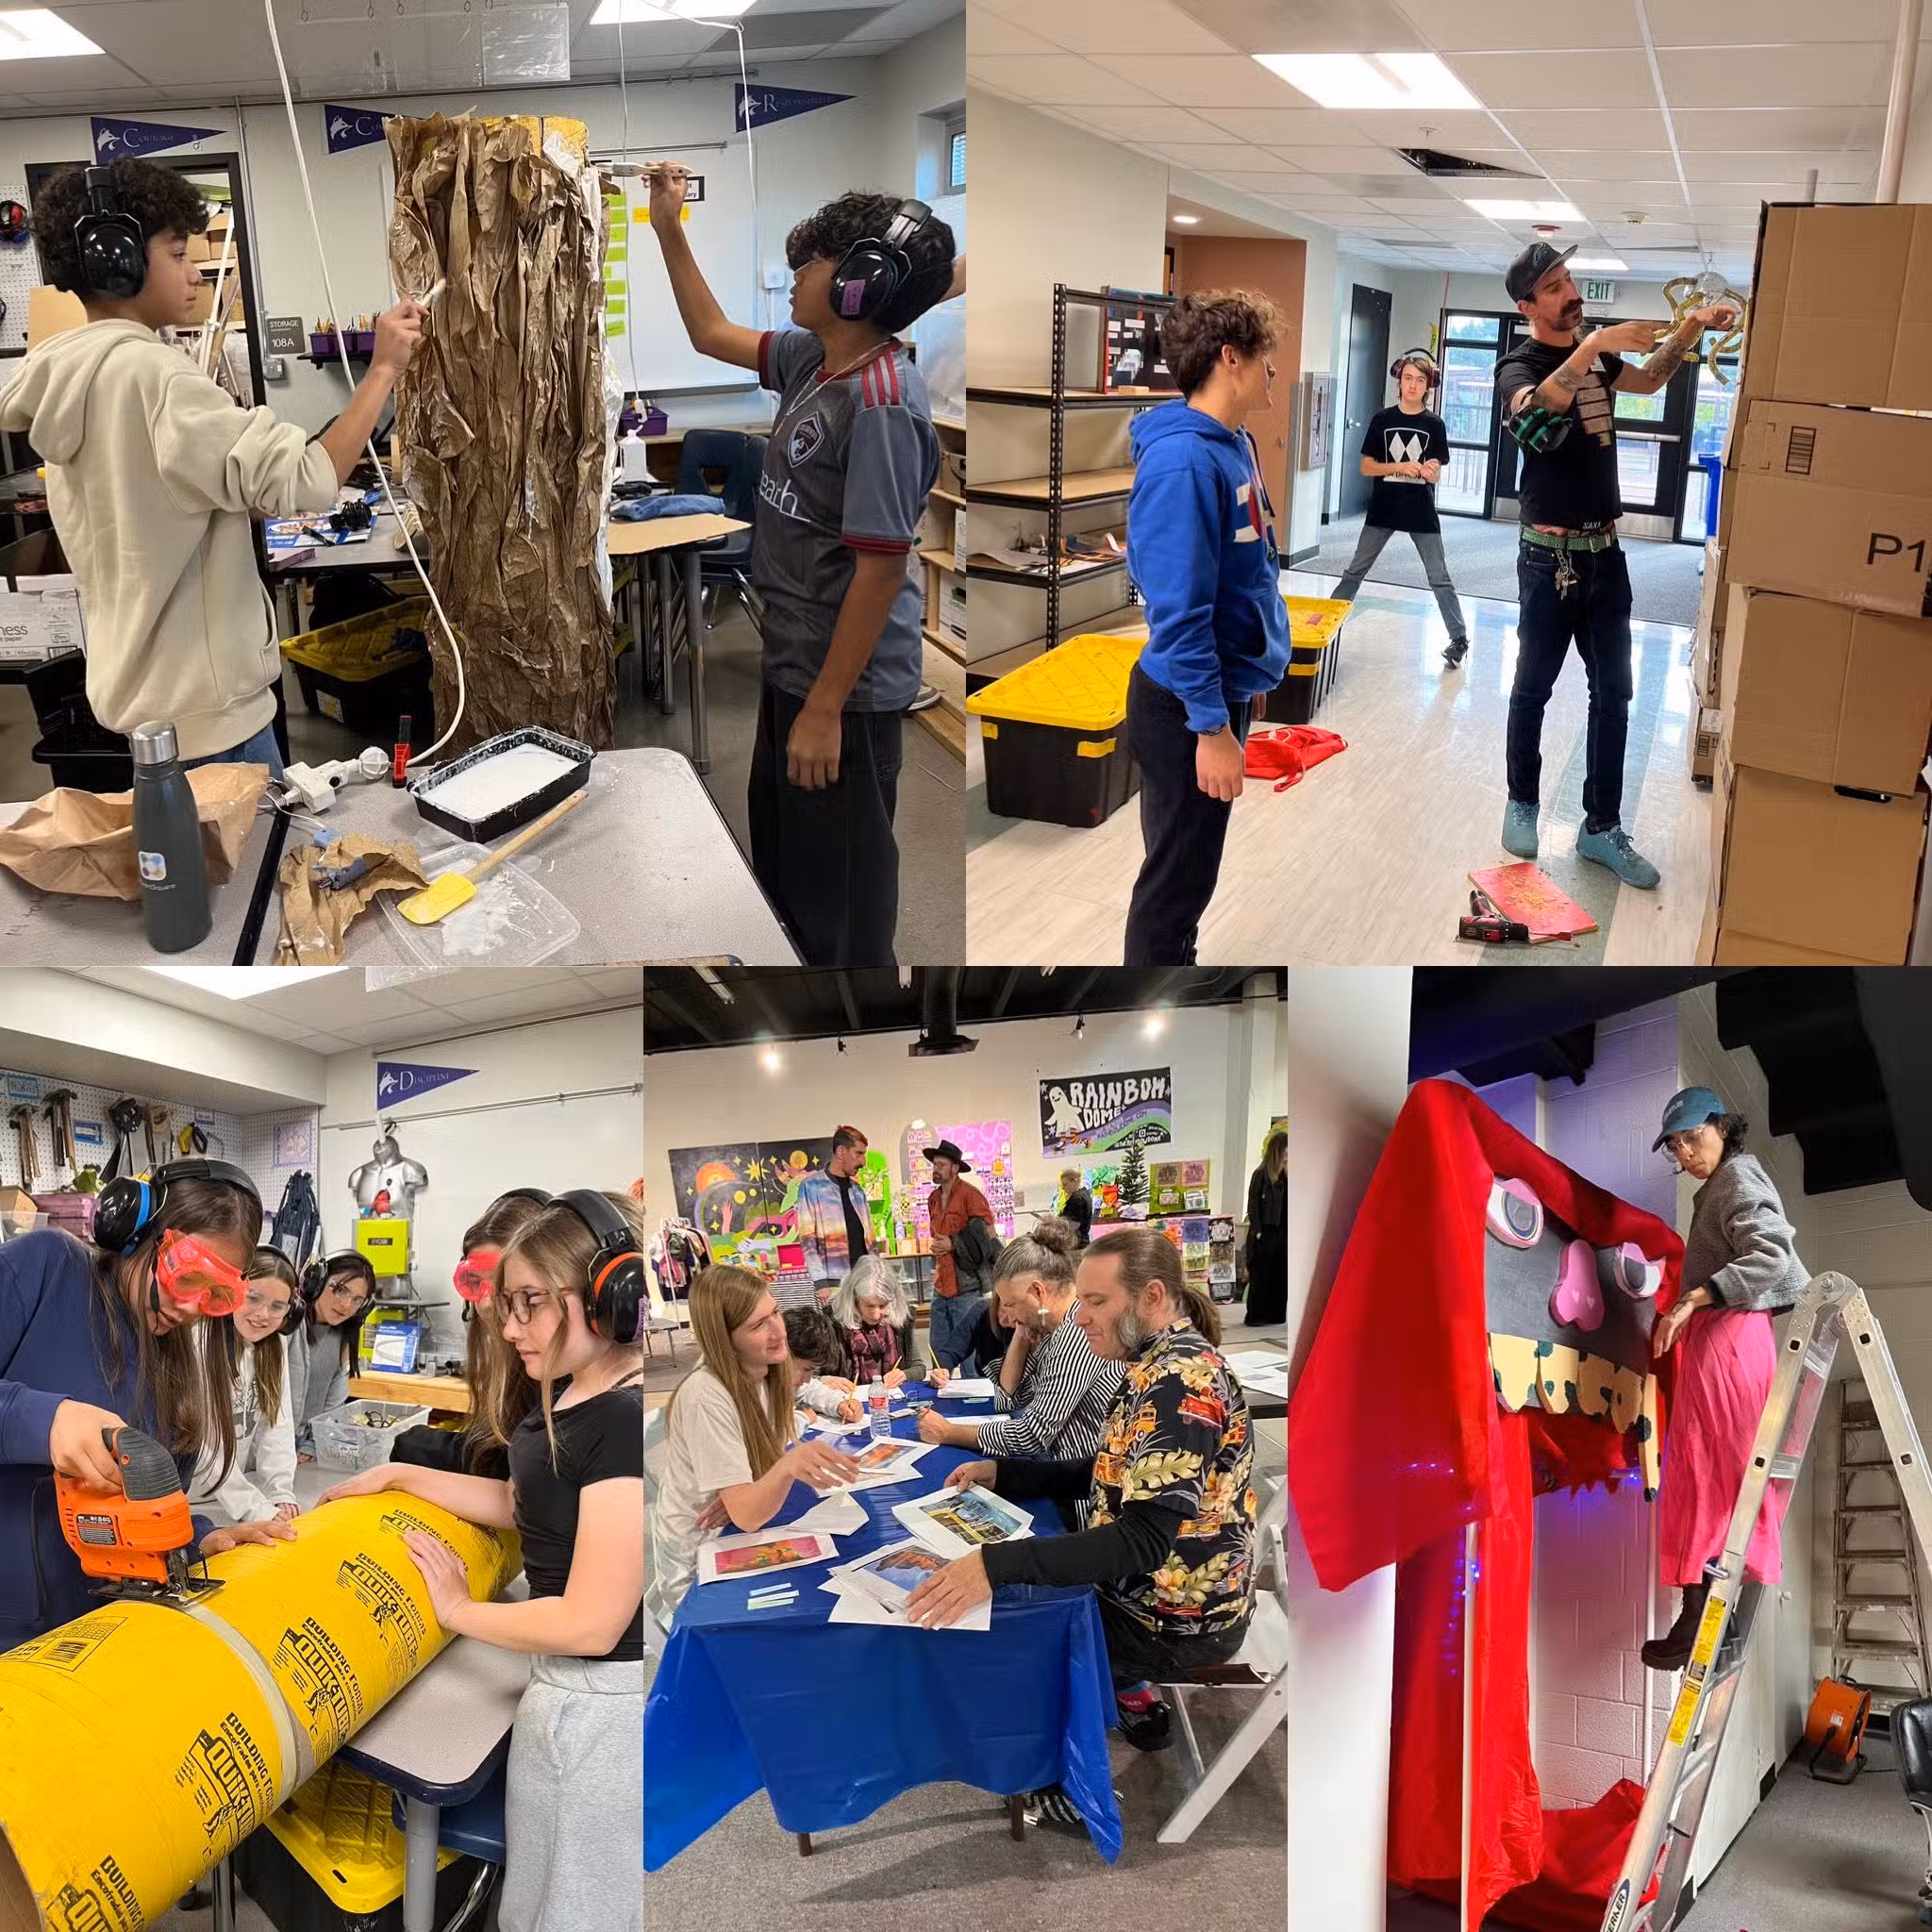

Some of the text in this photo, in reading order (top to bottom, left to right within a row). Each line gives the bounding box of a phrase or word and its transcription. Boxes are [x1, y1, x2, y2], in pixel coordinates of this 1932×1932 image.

[1587, 281, 1610, 300] EXIT
[272, 338, 294, 348] 108A
[1867, 532, 1926, 573] P1
[1070, 1076, 1166, 1108] RAINBOW
[1083, 1106, 1122, 1129] DOME
[394, 1508, 442, 1540] BUILDING
[358, 1552, 406, 1596] BUILDING
[305, 1616, 352, 1674] BUILDING
[334, 1663, 346, 1681] para
[220, 1721, 252, 1770] Encofrados
[248, 1770, 260, 1790] para
[225, 1711, 268, 1779] BUILDING
[206, 1738, 256, 1840] QUIK-TUB
[99, 1854, 142, 1924] BUILDING
